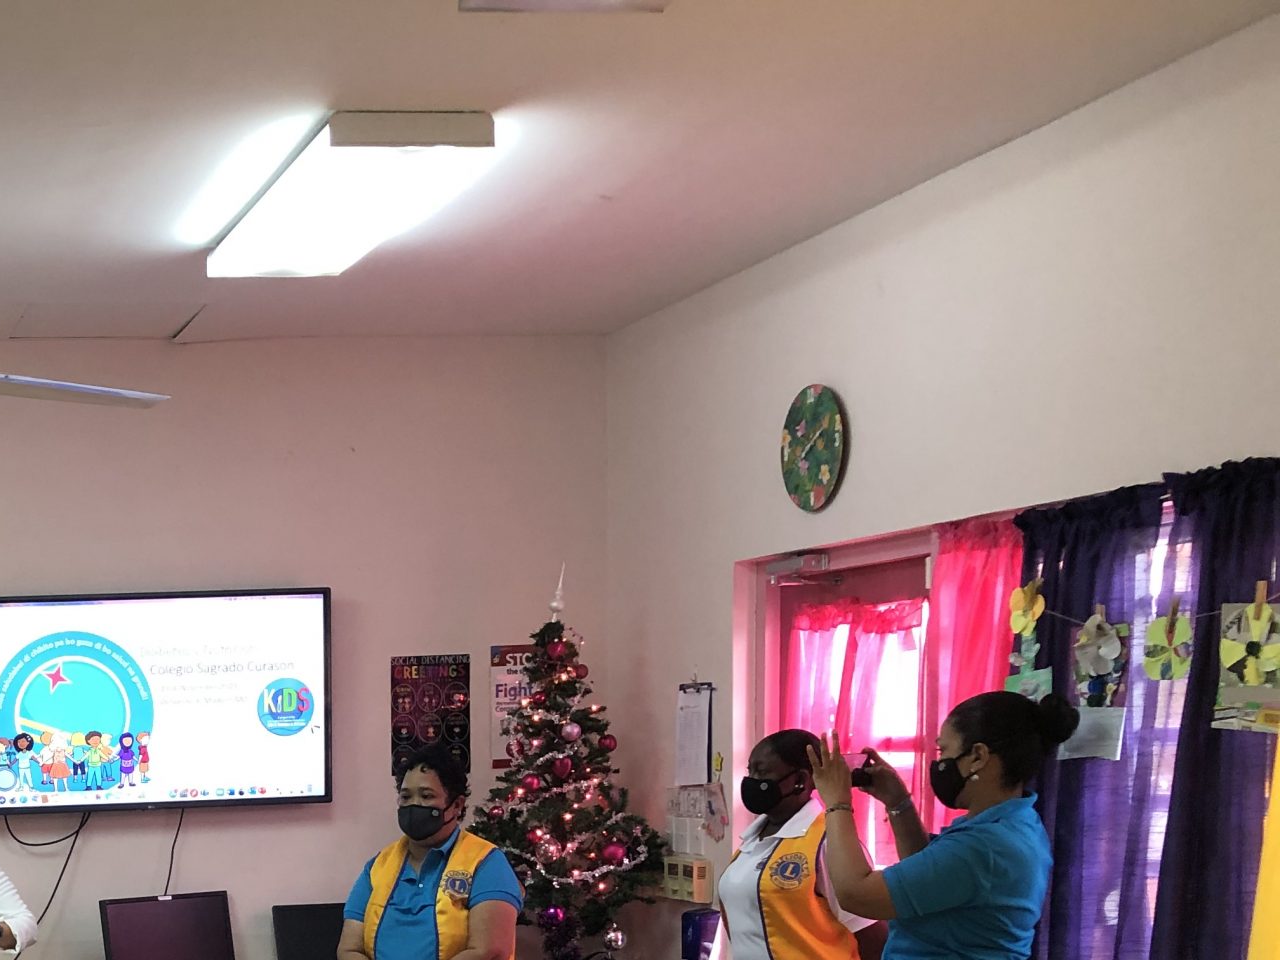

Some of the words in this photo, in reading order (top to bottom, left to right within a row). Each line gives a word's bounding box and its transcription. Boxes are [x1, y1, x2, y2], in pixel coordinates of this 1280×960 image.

[391, 656, 419, 665] SOCIAL
[150, 664, 194, 677] Colegio
[197, 662, 244, 675] Sagrado
[394, 665, 465, 679] GREETINGS
